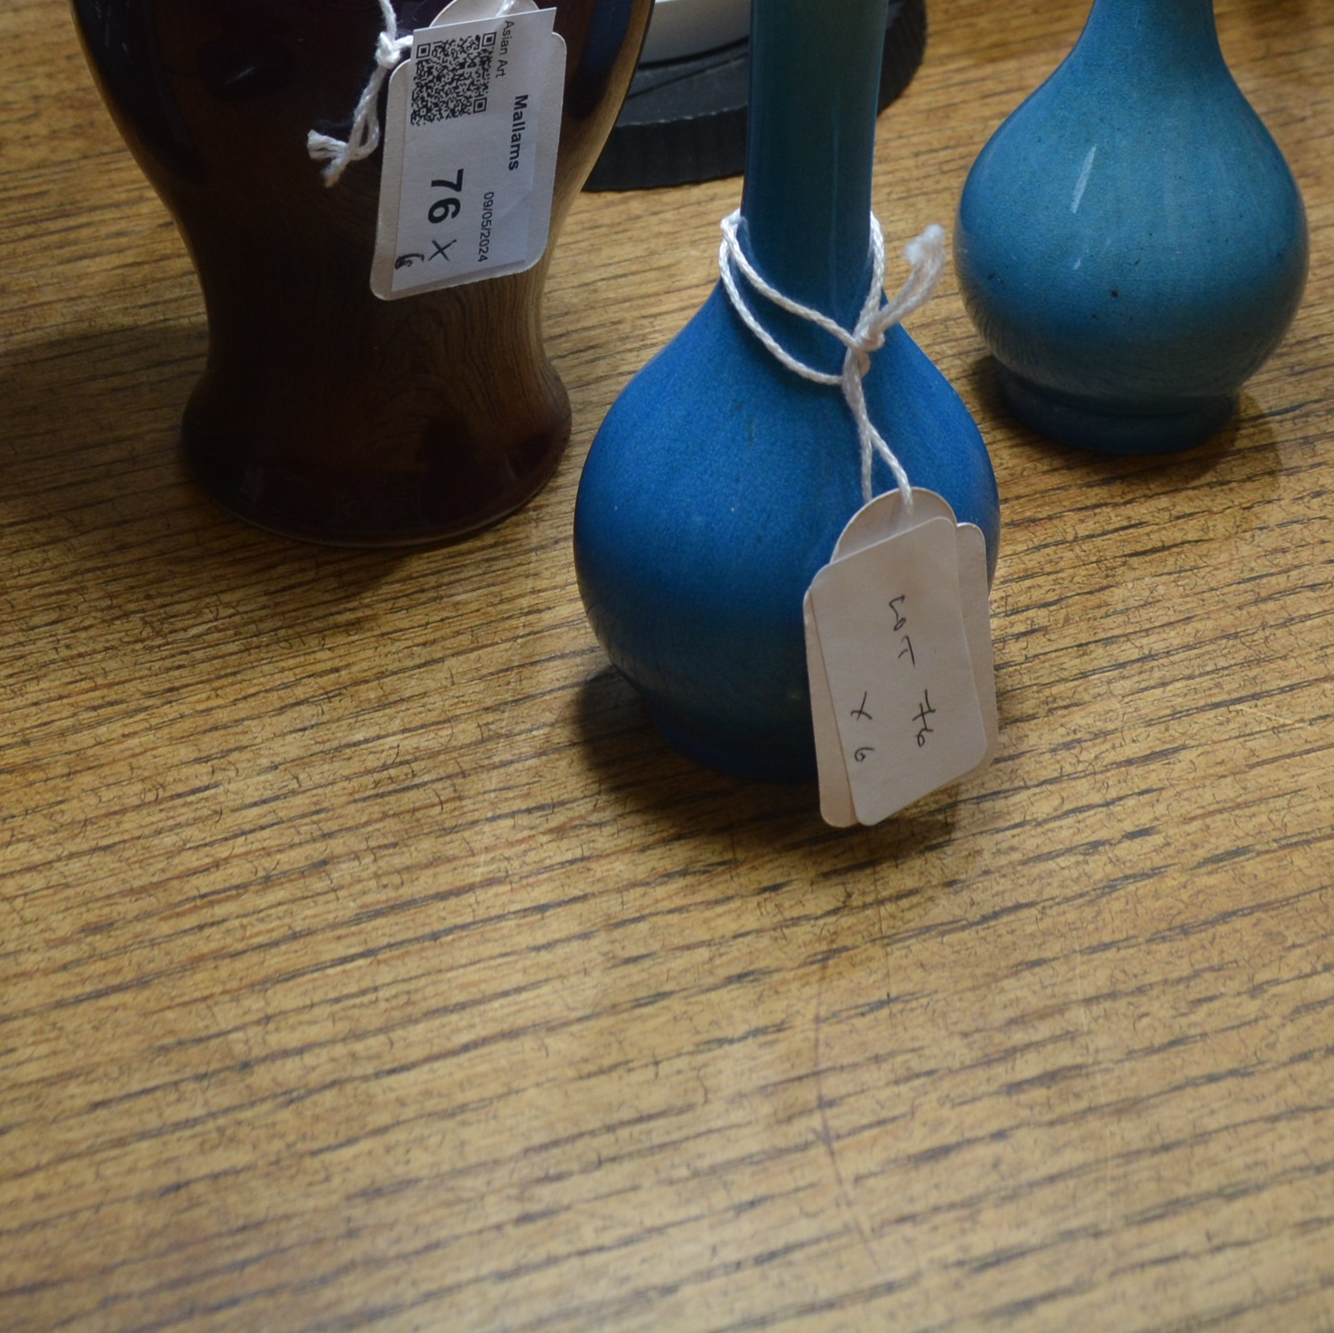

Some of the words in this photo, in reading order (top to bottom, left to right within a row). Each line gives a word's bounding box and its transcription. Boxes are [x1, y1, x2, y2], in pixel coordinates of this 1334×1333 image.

[502, 20, 515, 56] Asian
[495, 59, 508, 78] Art
[508, 94, 529, 171] Mallams
[428, 168, 465, 224] 76
[478, 191, 495, 263] 09/05/2024
